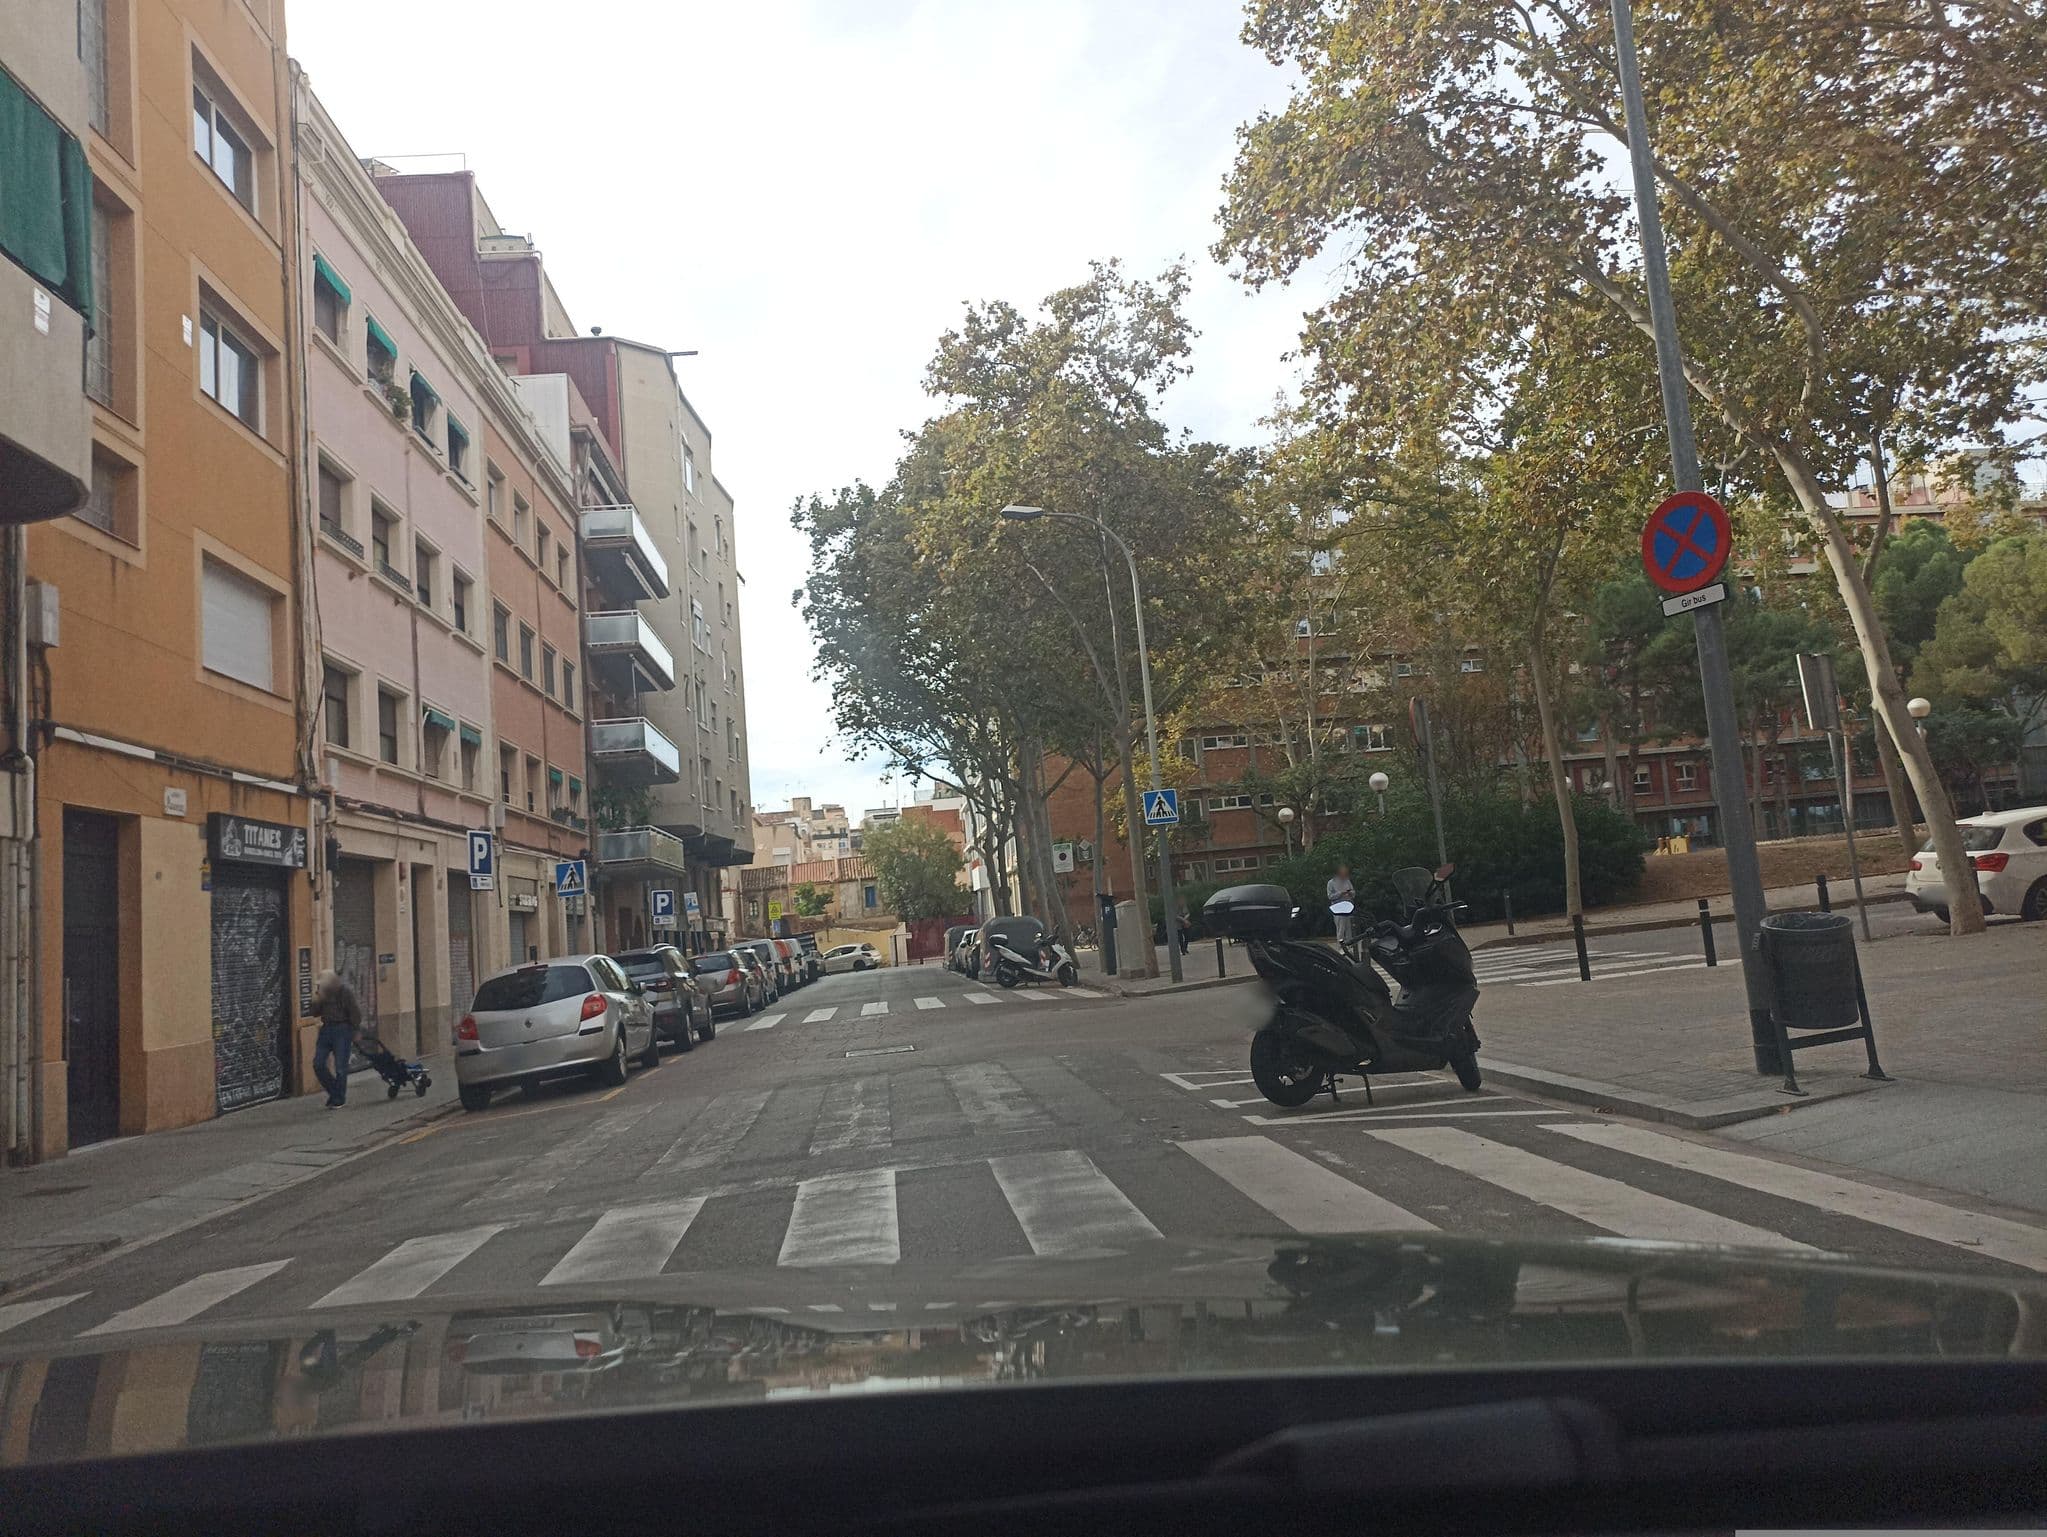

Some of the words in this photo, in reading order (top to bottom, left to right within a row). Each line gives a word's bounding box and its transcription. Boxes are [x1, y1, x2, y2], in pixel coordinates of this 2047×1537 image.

[1681, 597, 1692, 608] Gir
[1693, 594, 1707, 604] bus
[243, 824, 282, 849] TITANES
[473, 836, 488, 870] P
[656, 893, 670, 914] P
